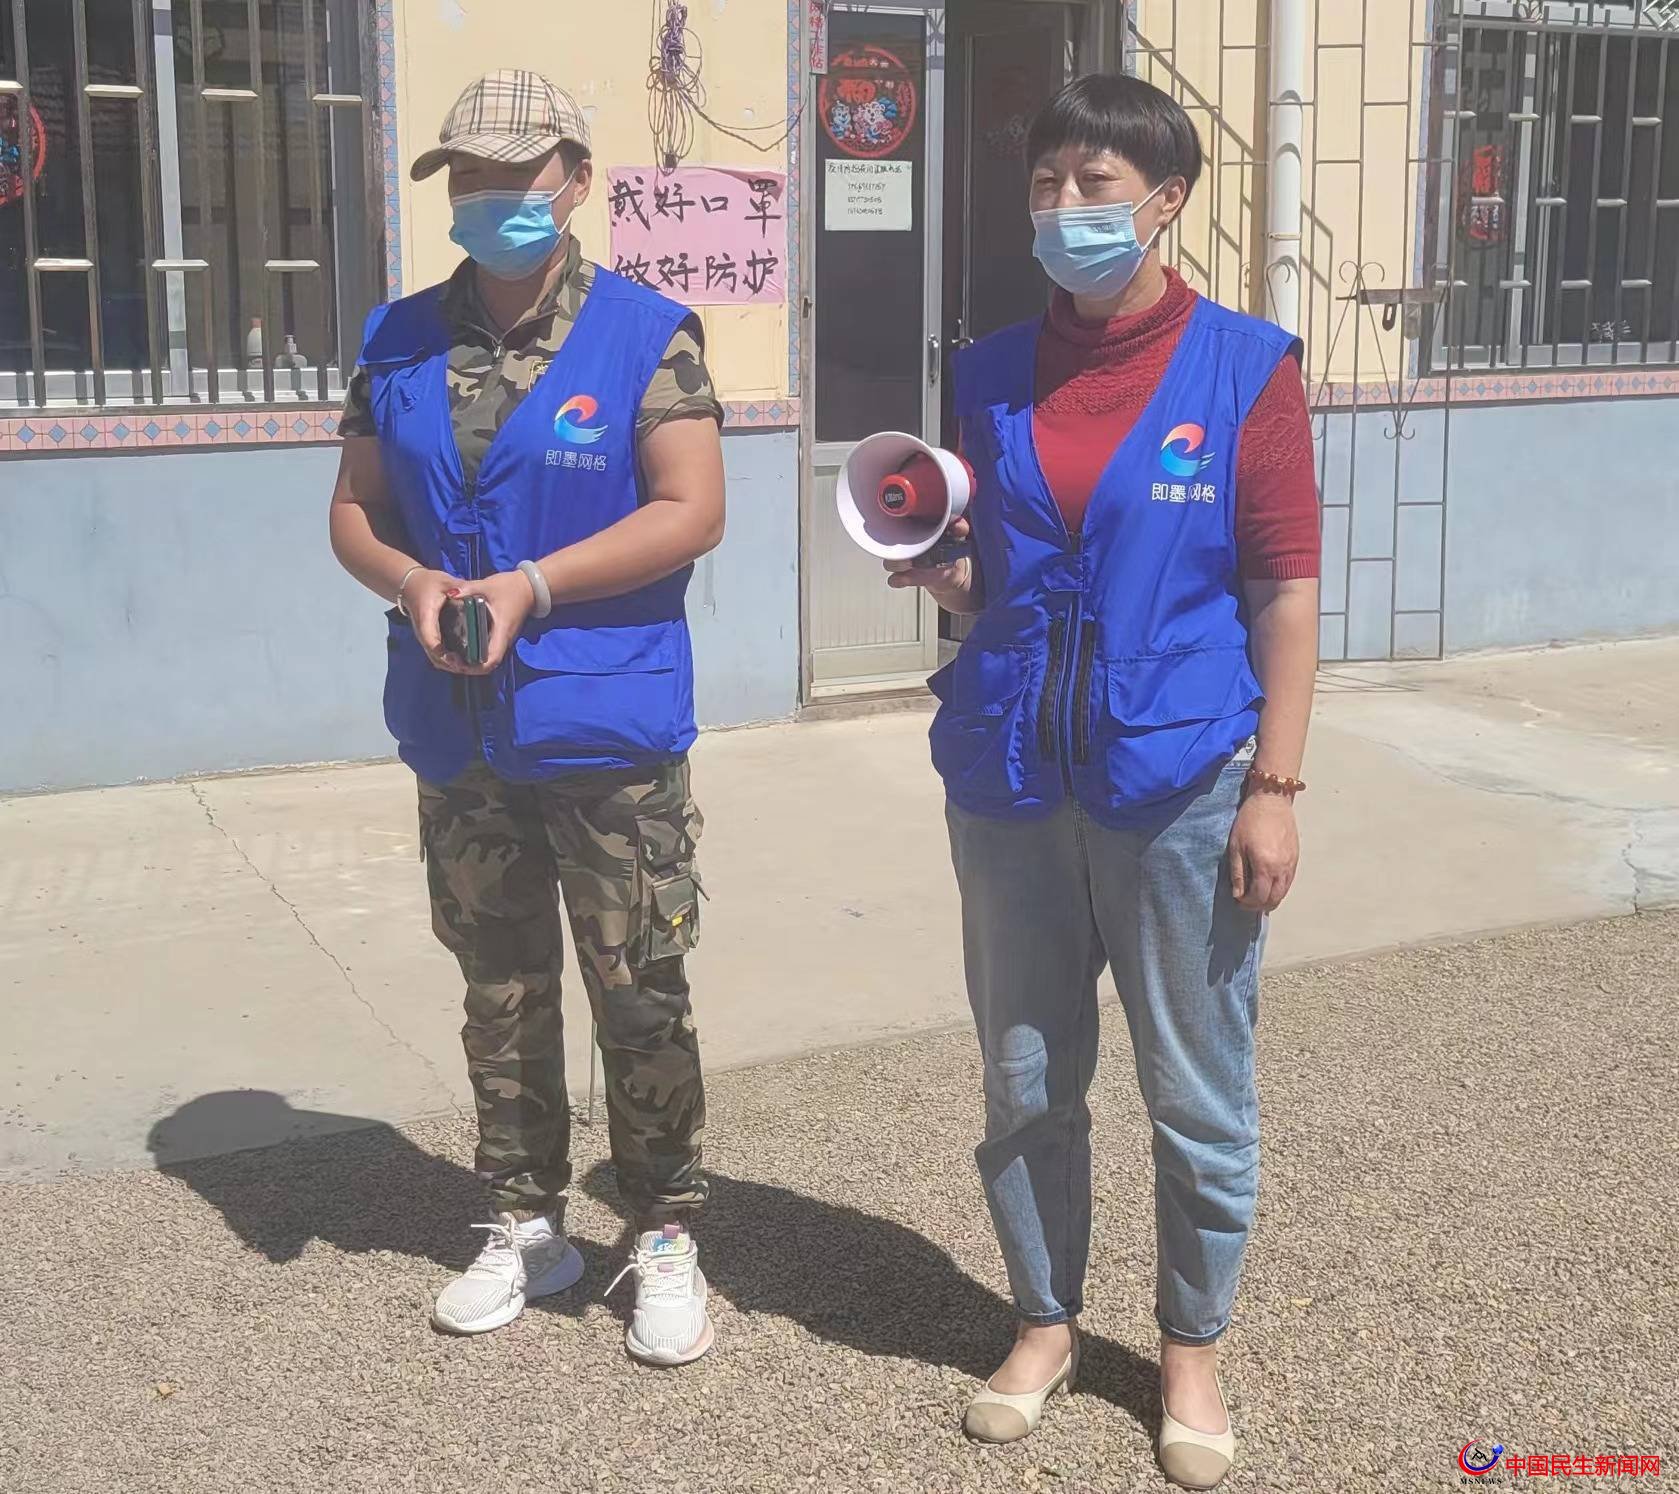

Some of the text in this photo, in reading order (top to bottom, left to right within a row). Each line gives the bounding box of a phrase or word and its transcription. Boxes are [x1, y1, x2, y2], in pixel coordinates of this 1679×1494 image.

[609, 176, 782, 238] 戴好口罩
[614, 249, 780, 294] 做好防护
[544, 449, 607, 471] 即墨网格
[1151, 482, 1216, 504] 即墨网格
